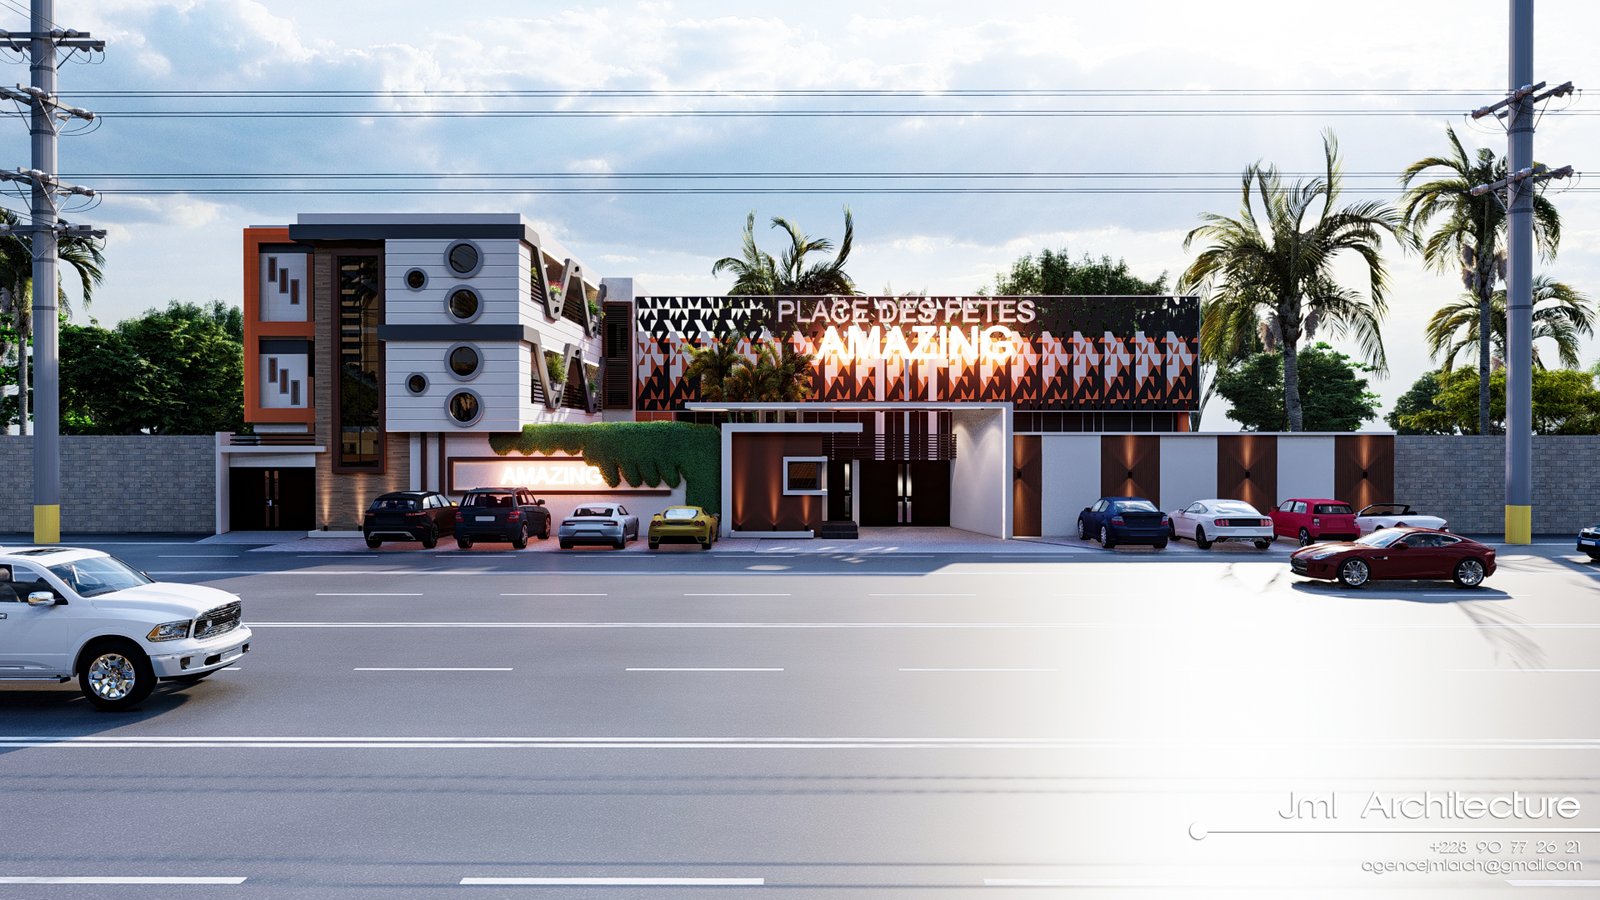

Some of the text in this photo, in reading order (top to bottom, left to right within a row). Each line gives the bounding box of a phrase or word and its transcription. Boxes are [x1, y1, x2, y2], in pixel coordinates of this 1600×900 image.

[778, 300, 1036, 323] PLACE DES FETES
[817, 326, 1015, 360] AMAZING
[500, 466, 603, 485] AMAZING
